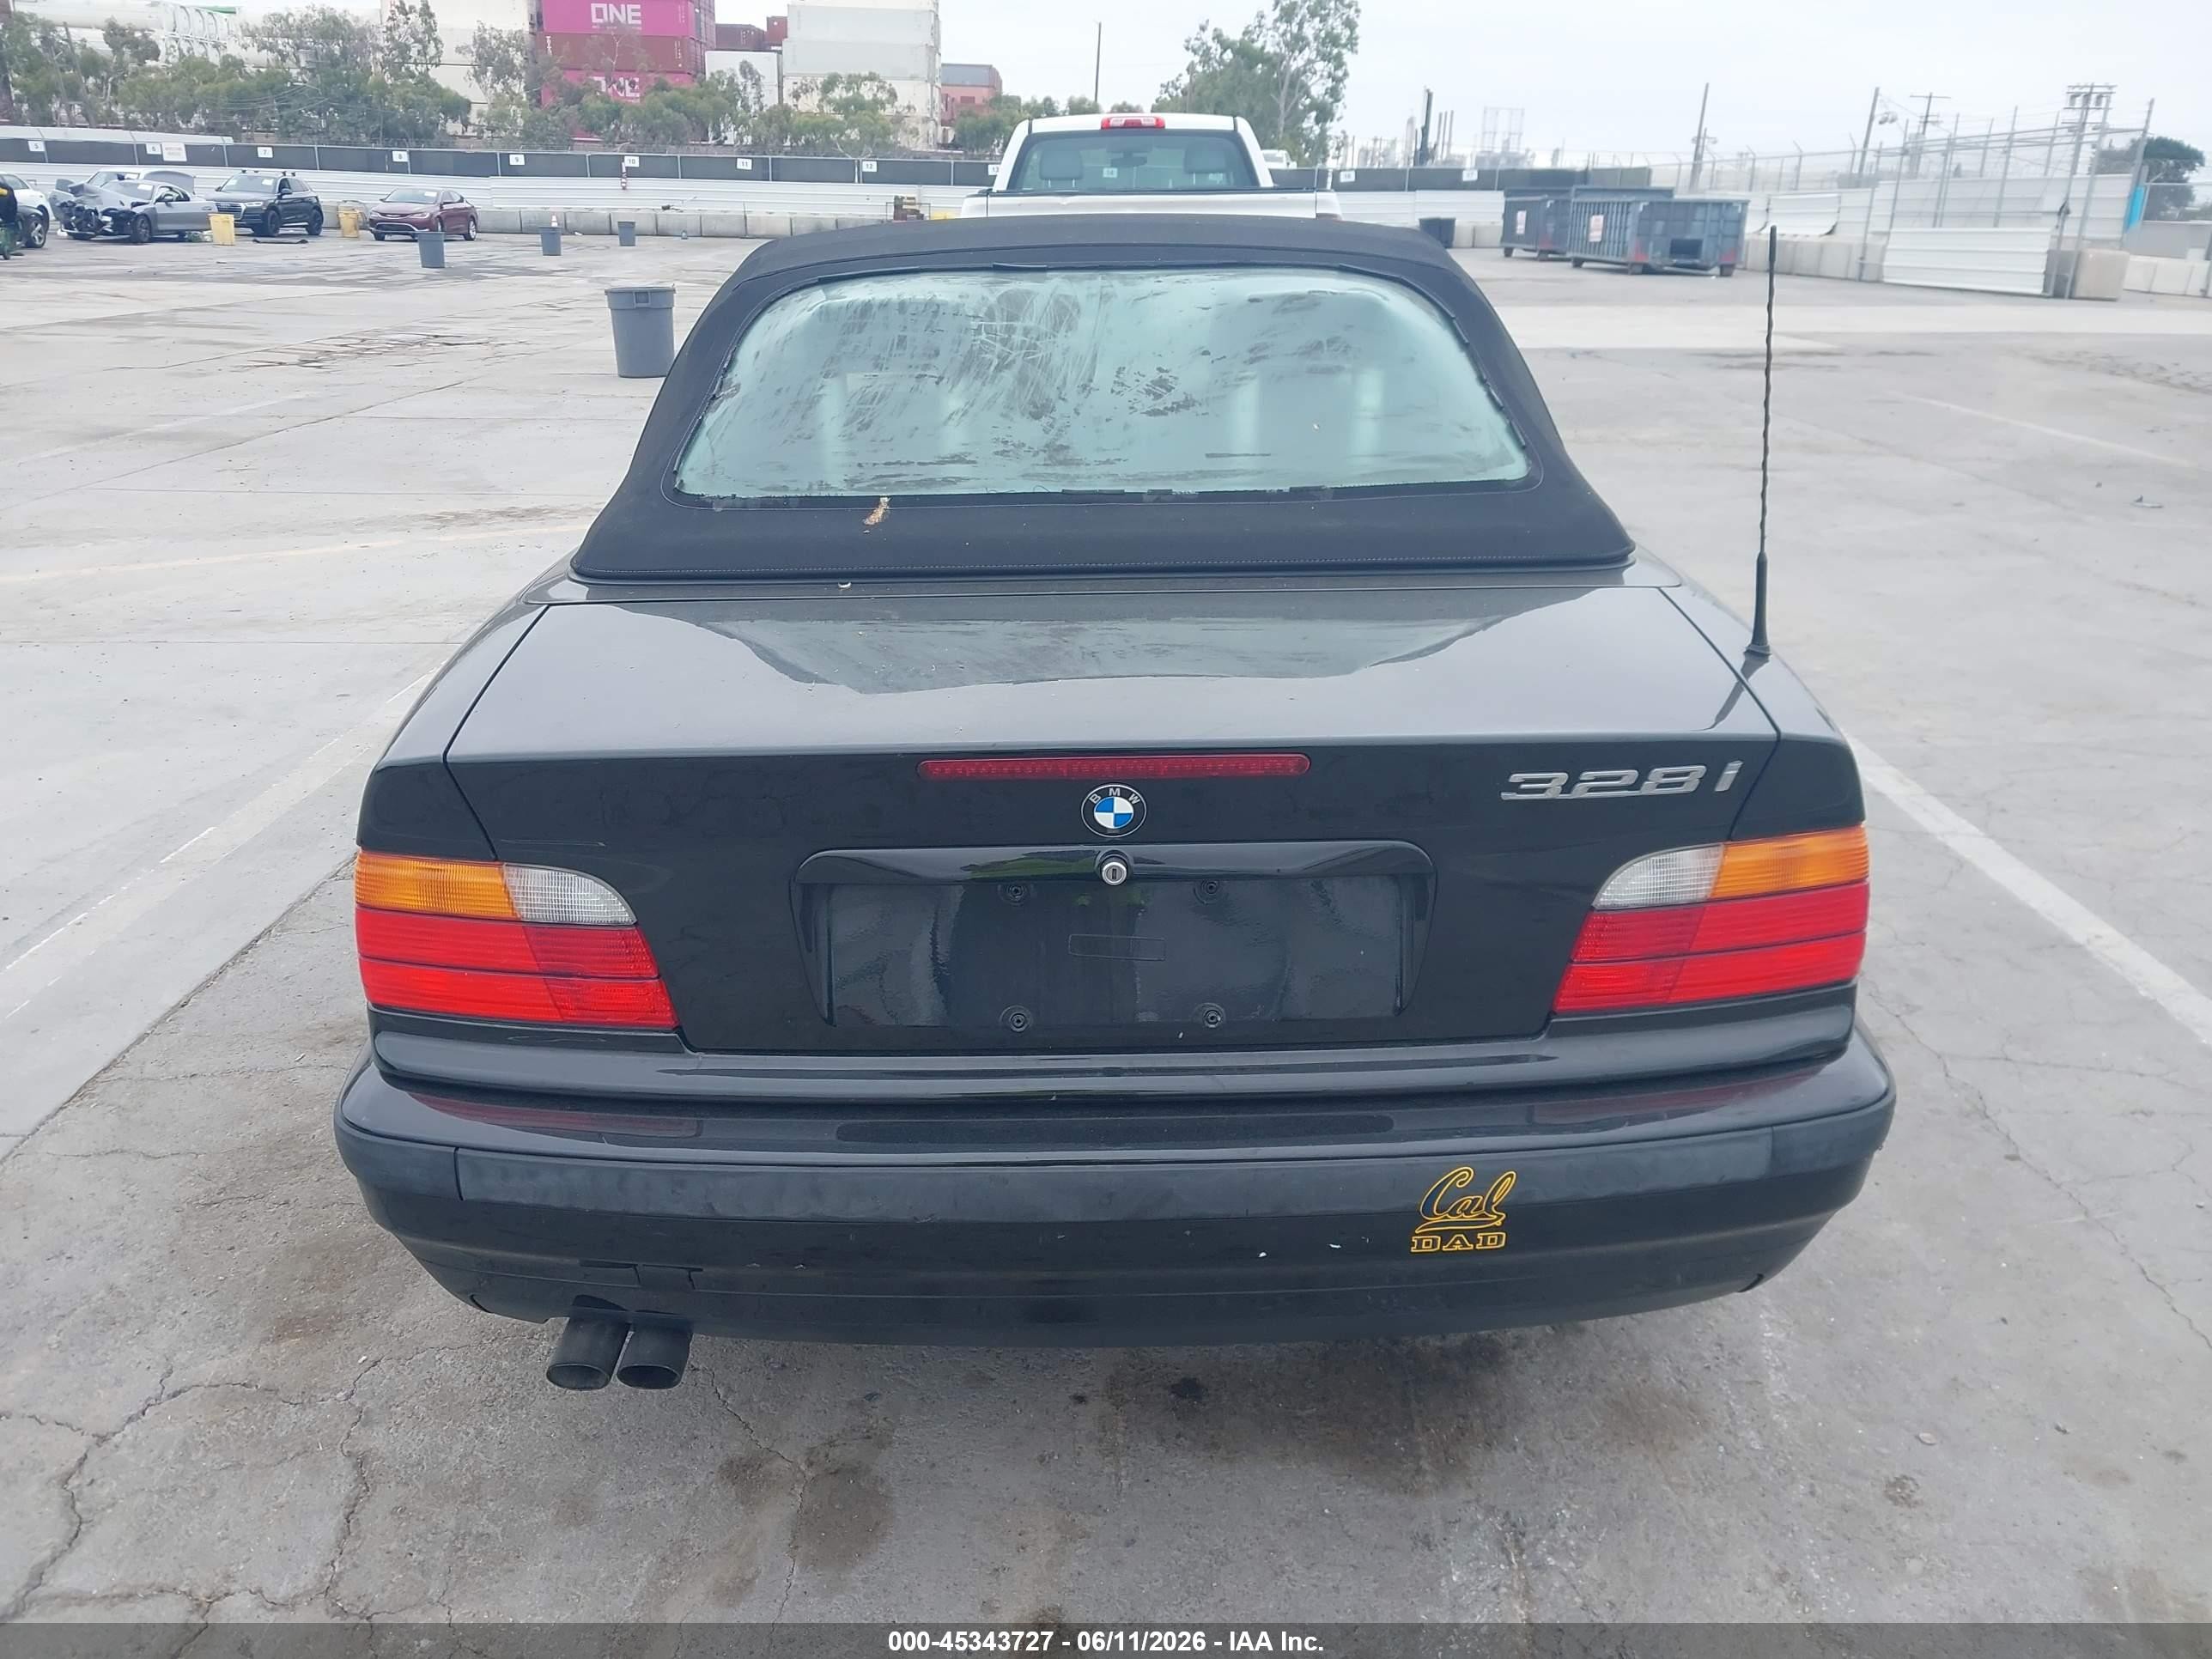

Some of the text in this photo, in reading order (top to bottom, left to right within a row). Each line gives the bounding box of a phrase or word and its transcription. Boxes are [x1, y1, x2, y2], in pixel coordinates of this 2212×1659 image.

[591, 3, 642, 24] ONE
[1501, 760, 1743, 800] 328i
[1089, 787, 1141, 805] BMW
[1414, 1166, 1516, 1234] Cal
[1410, 1231, 1506, 1253] DAD
